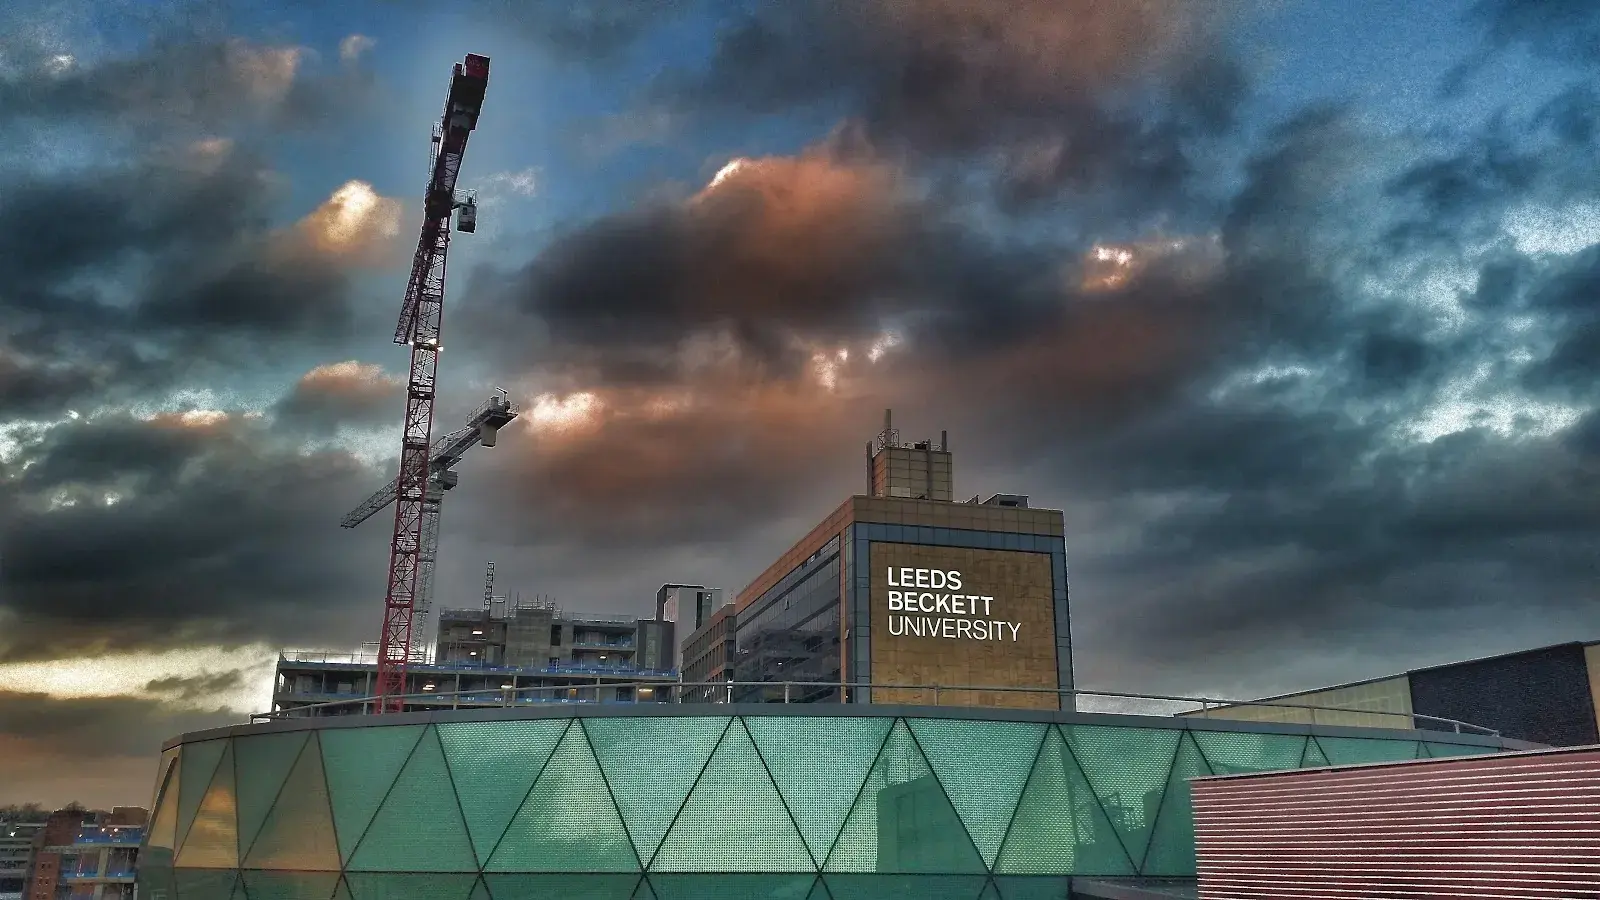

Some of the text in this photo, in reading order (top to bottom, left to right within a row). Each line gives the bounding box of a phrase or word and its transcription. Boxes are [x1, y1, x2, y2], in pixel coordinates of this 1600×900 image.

[887, 566, 963, 590] LEEDS
[888, 590, 994, 615] BECKETT
[888, 615, 1022, 642] UNIVERSITY
